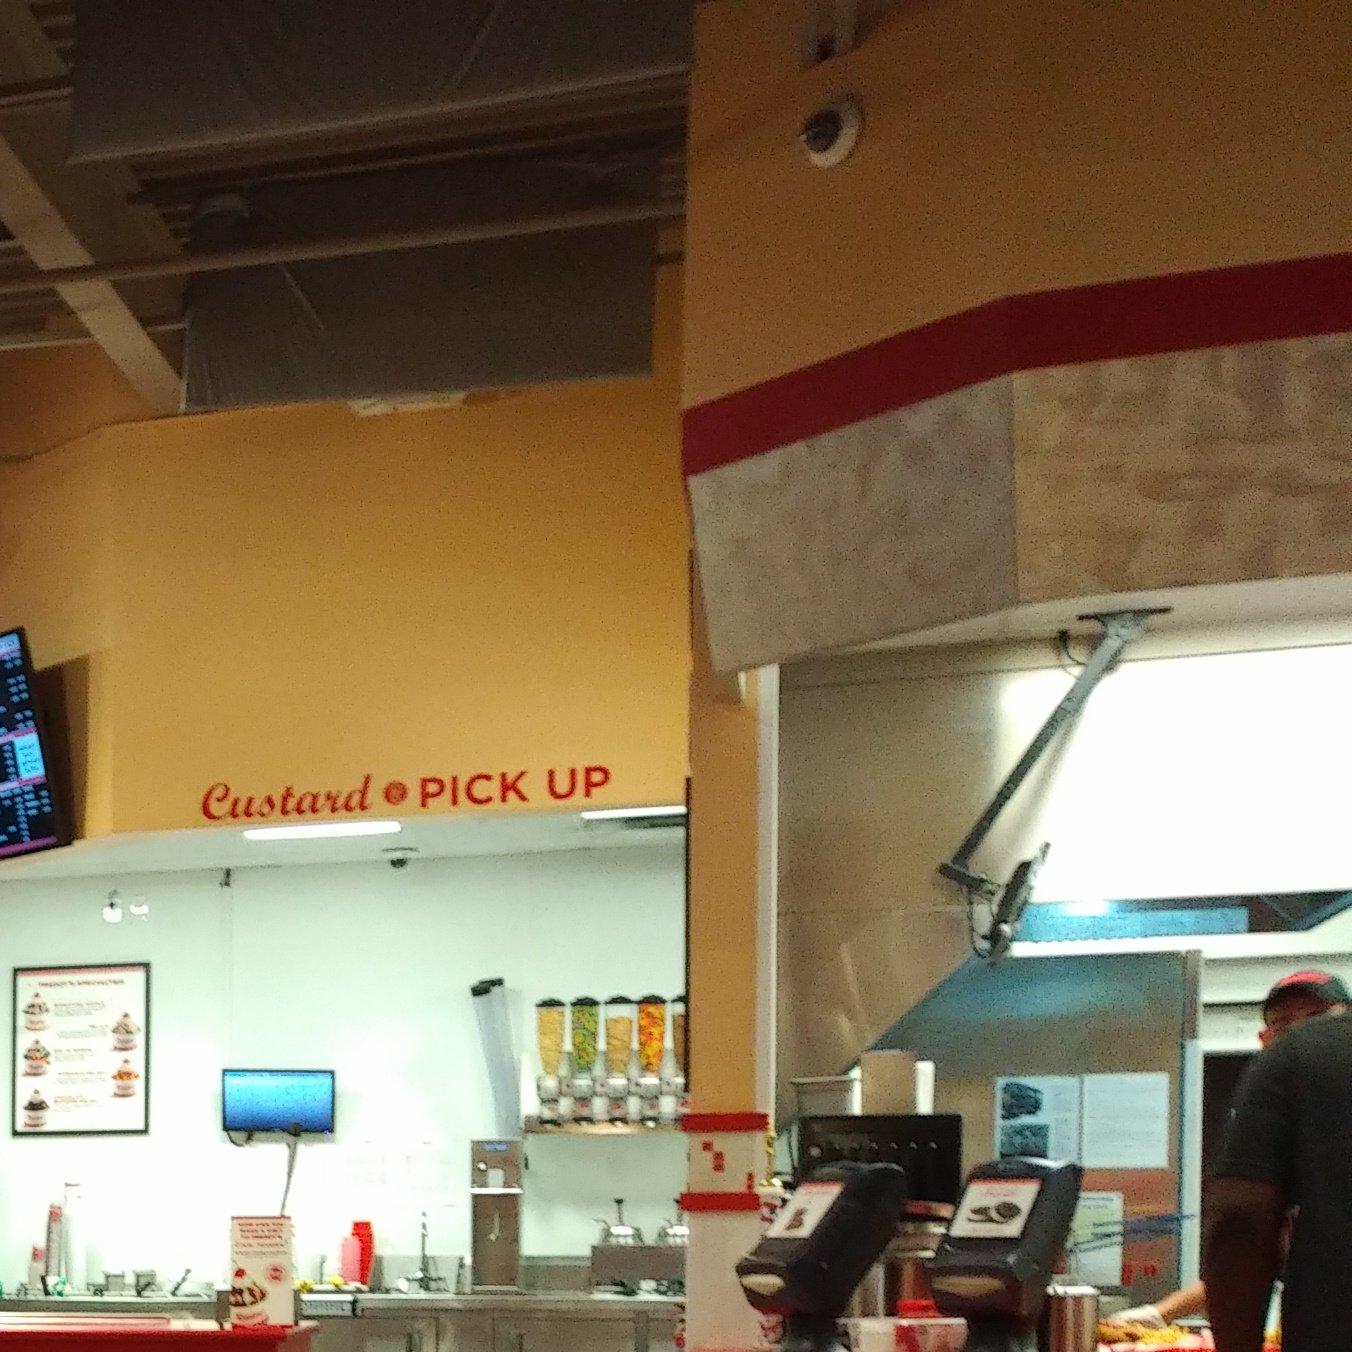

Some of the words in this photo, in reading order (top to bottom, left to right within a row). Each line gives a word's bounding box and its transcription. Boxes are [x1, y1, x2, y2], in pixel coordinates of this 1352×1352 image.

[200, 773, 374, 821] Custard
[419, 769, 530, 808] PICK
[547, 764, 612, 801] UP
